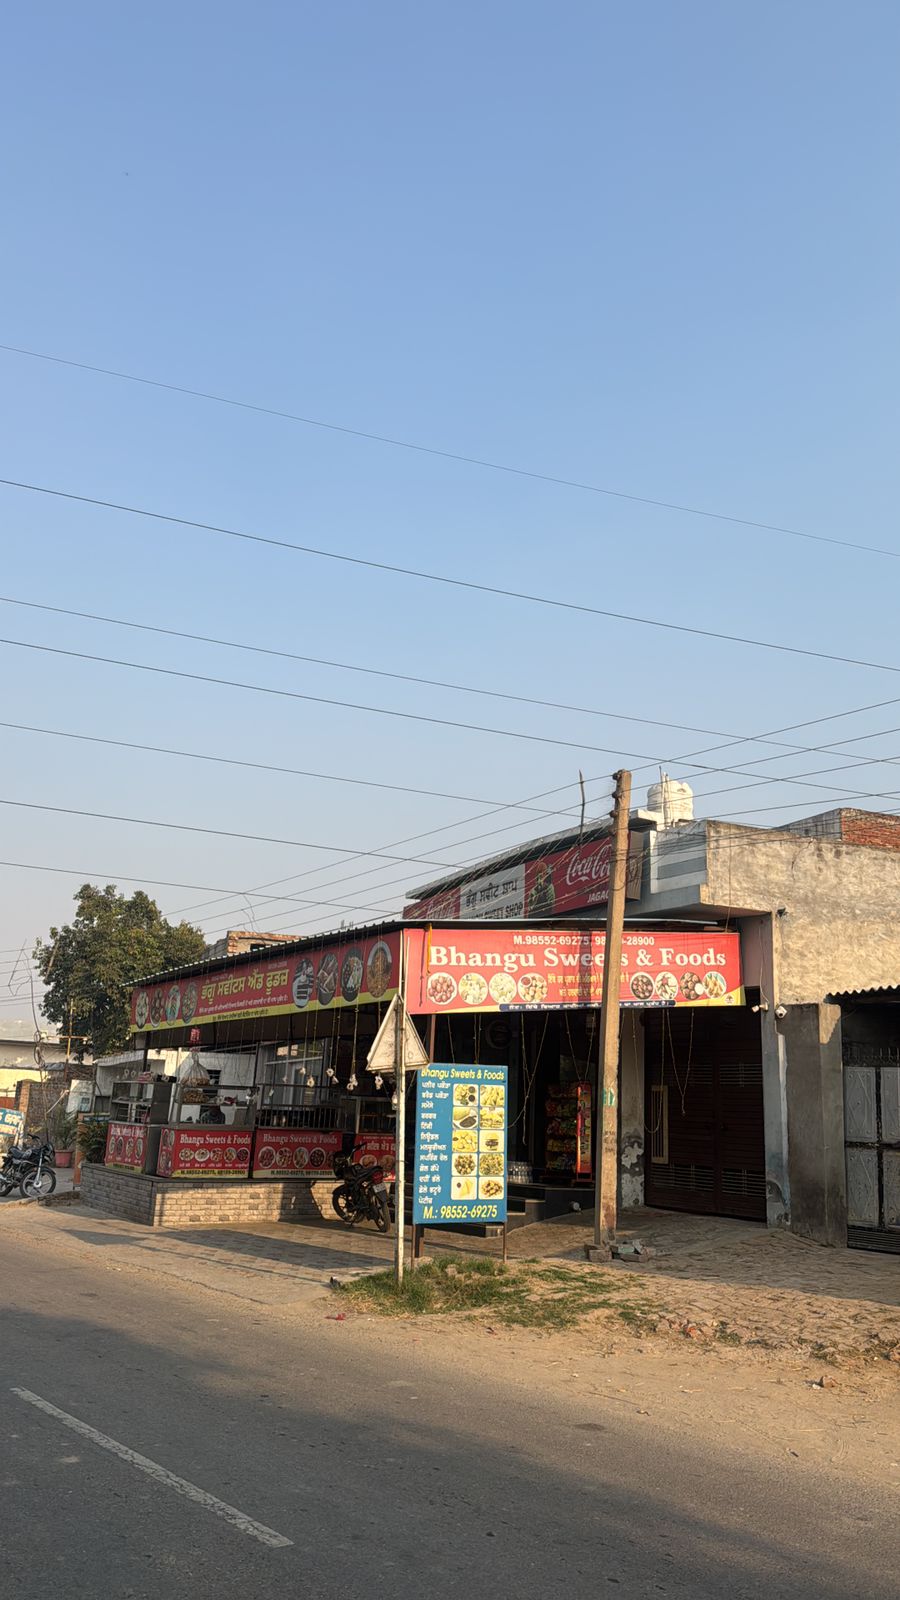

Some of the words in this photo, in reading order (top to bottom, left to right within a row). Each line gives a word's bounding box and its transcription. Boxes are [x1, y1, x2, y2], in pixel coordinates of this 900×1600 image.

[480, 882, 499, 902] ਸਵੀਟ
[595, 935, 655, 947] 98-28900
[429, 945, 536, 973] Bhangu
[544, 947, 629, 968] Swees
[636, 948, 654, 967] &
[660, 947, 727, 967] Foods
[201, 980, 217, 1005] ਭੰਗੂ
[217, 974, 246, 997] ਸਵੀਟਸ
[421, 1067, 450, 1080] Bhangu
[450, 1068, 476, 1080] Sweets
[476, 1069, 483, 1080] &
[483, 1070, 505, 1081] Foods
[180, 1133, 204, 1147] Bhangu
[205, 1134, 226, 1145] Sweets
[232, 1134, 251, 1145] Foods
[263, 1133, 288, 1145] Bhangu
[289, 1134, 311, 1144] Sweets
[319, 1134, 338, 1145] Foods
[440, 1205, 498, 1220] 98552-69275
